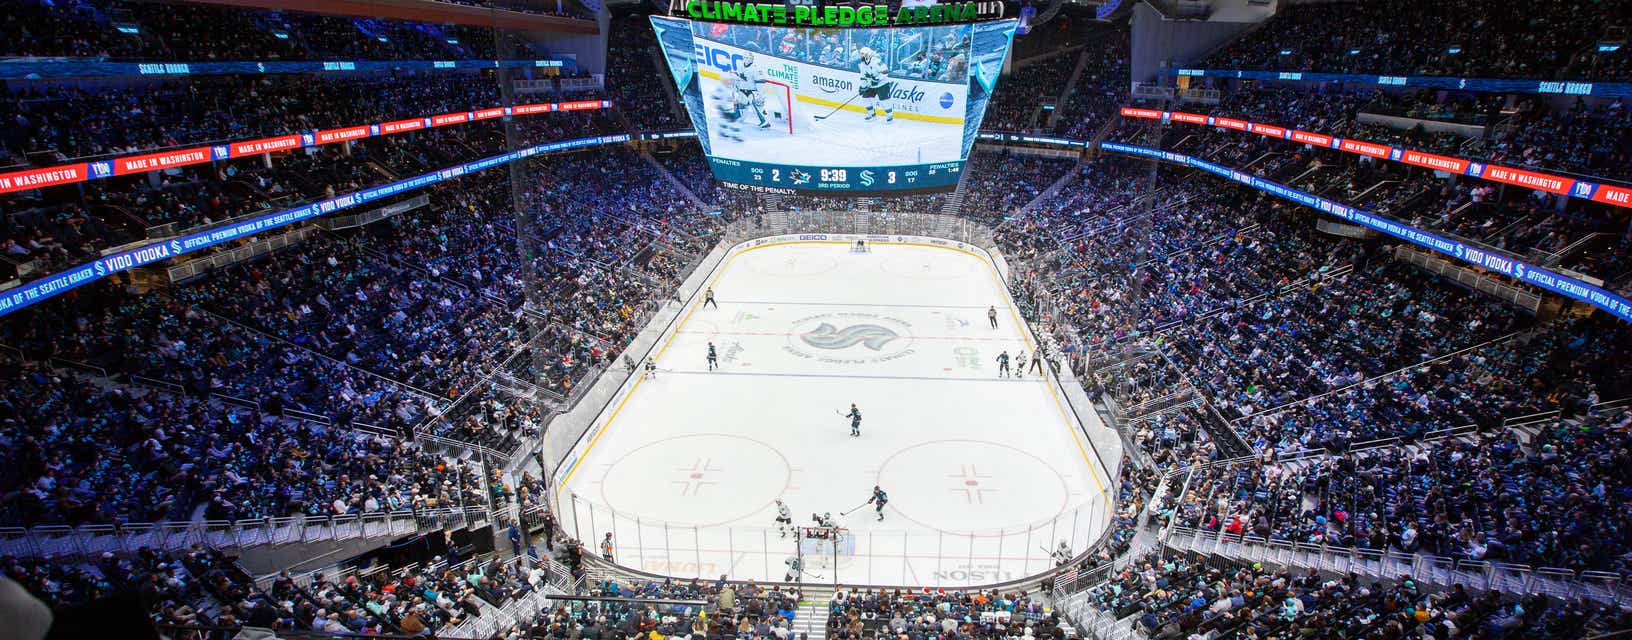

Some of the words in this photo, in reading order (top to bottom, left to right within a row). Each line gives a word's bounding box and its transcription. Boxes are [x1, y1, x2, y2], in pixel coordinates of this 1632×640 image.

[688, 1, 785, 23] CLIMATE
[795, 6, 887, 25] PLEDGE
[898, 2, 976, 24] ARENA
[812, 74, 852, 91] amazon
[889, 81, 925, 103] laska
[238, 145, 254, 154] MADE
[263, 139, 296, 150] WASHINGTON
[125, 158, 147, 170] MADE
[150, 157, 158, 167] IN
[160, 152, 203, 165] WASHINGTON
[713, 158, 740, 166] PENALTIES
[1408, 154, 1420, 162] MADE
[1428, 157, 1460, 170] WASHINGTON
[0, 178, 11, 189] IN
[14, 169, 77, 187] WASHINGTON
[772, 169, 780, 181] 2
[821, 169, 846, 182] 9:39
[888, 172, 896, 184] 3
[1491, 169, 1508, 180] MADE
[1509, 173, 1516, 181] IN
[1518, 174, 1562, 190] WASHINGTON
[320, 202, 335, 212] VIDO
[336, 196, 354, 208] VODKA
[1606, 190, 1630, 203] MADE
[184, 235, 211, 249] OFFICIAL
[212, 228, 237, 242] PREMIUM
[238, 224, 256, 235] VODKA
[264, 219, 273, 227] THE
[274, 214, 294, 224] SEATTLE
[1407, 230, 1415, 239] THE
[1416, 232, 1434, 246] SEATTLE
[105, 255, 132, 272] VIDO
[133, 245, 170, 264] VODKA
[1465, 248, 1483, 263] VIDO
[1485, 254, 1512, 273] VODKA
[14, 293, 24, 305] OF
[25, 288, 39, 301] THE
[40, 276, 69, 294] SEATTLE
[69, 268, 94, 285] KRAKEN
[1527, 270, 1555, 287] OFFICIAL
[1556, 280, 1590, 298] PREMIUM
[1590, 290, 1610, 306] VODKA
[1609, 299, 1619, 310] OF
[1618, 303, 1630, 317] THE
